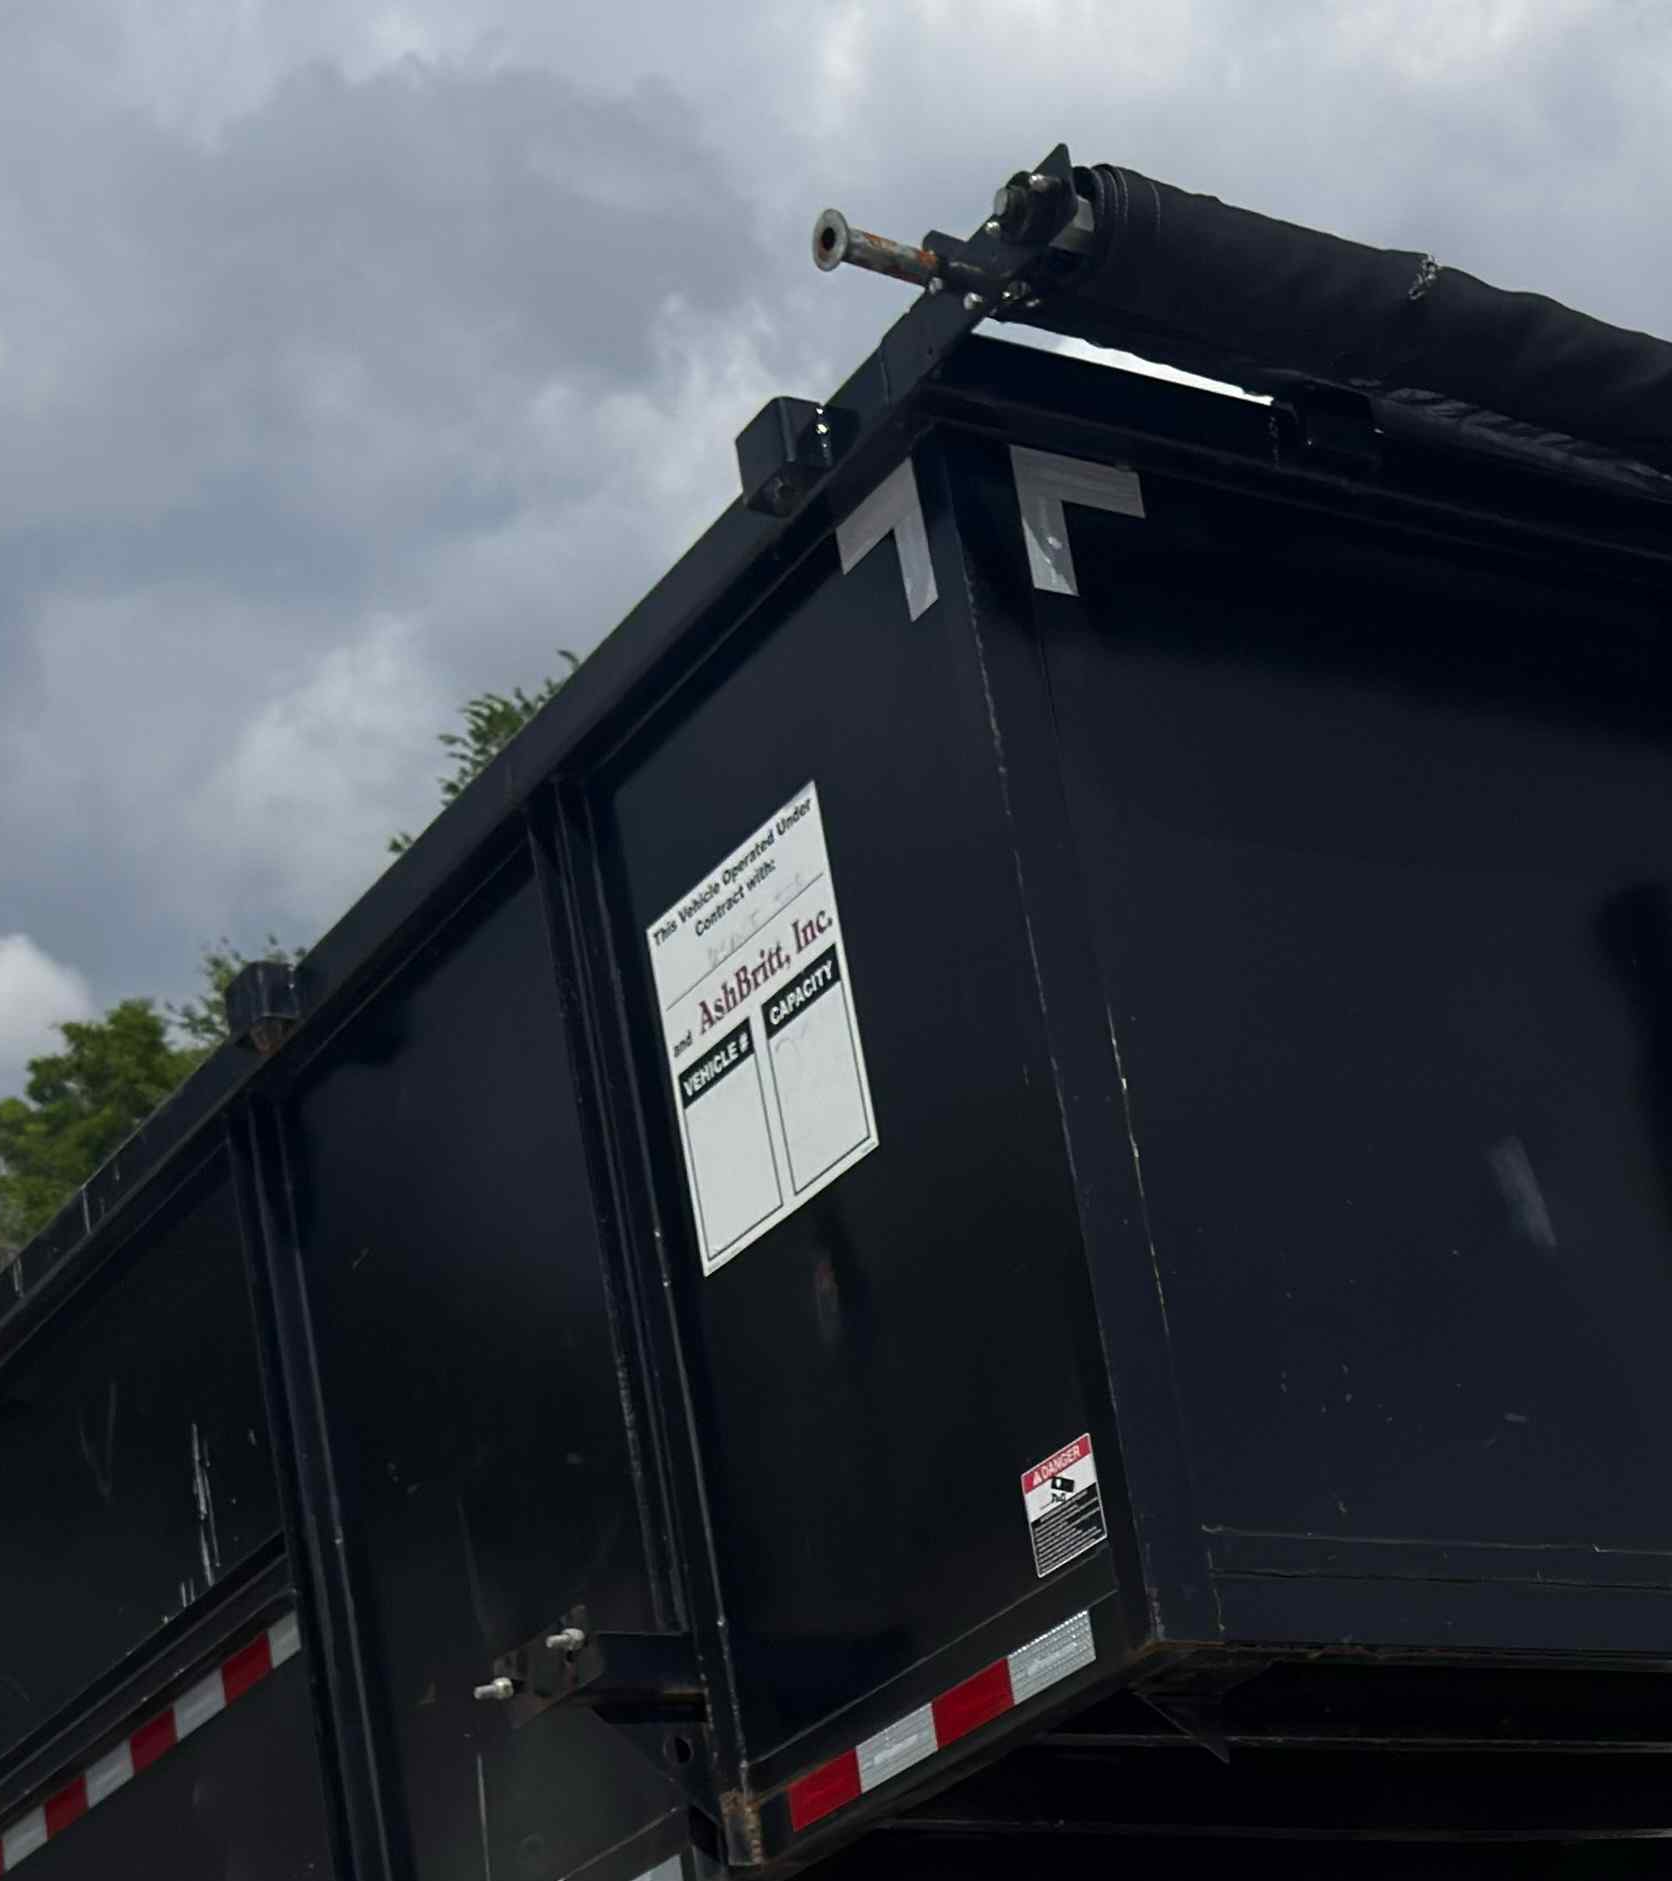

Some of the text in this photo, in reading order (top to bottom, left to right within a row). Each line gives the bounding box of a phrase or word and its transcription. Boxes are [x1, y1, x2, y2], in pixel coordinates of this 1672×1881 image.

[652, 919, 678, 947] This
[677, 881, 721, 924] Vehicle
[721, 828, 776, 886] Operated
[775, 798, 812, 837] Under
[694, 885, 745, 937] Contract
[746, 858, 777, 892] with:
[673, 1029, 693, 1058] and
[698, 938, 792, 1036] AshBritt,
[791, 909, 834, 955] Inc.
[768, 959, 833, 1026] CAPACITY
[682, 1040, 739, 1097] VEHICLE
[738, 1031, 750, 1053] #
[1040, 1443, 1081, 1480] DANGER
